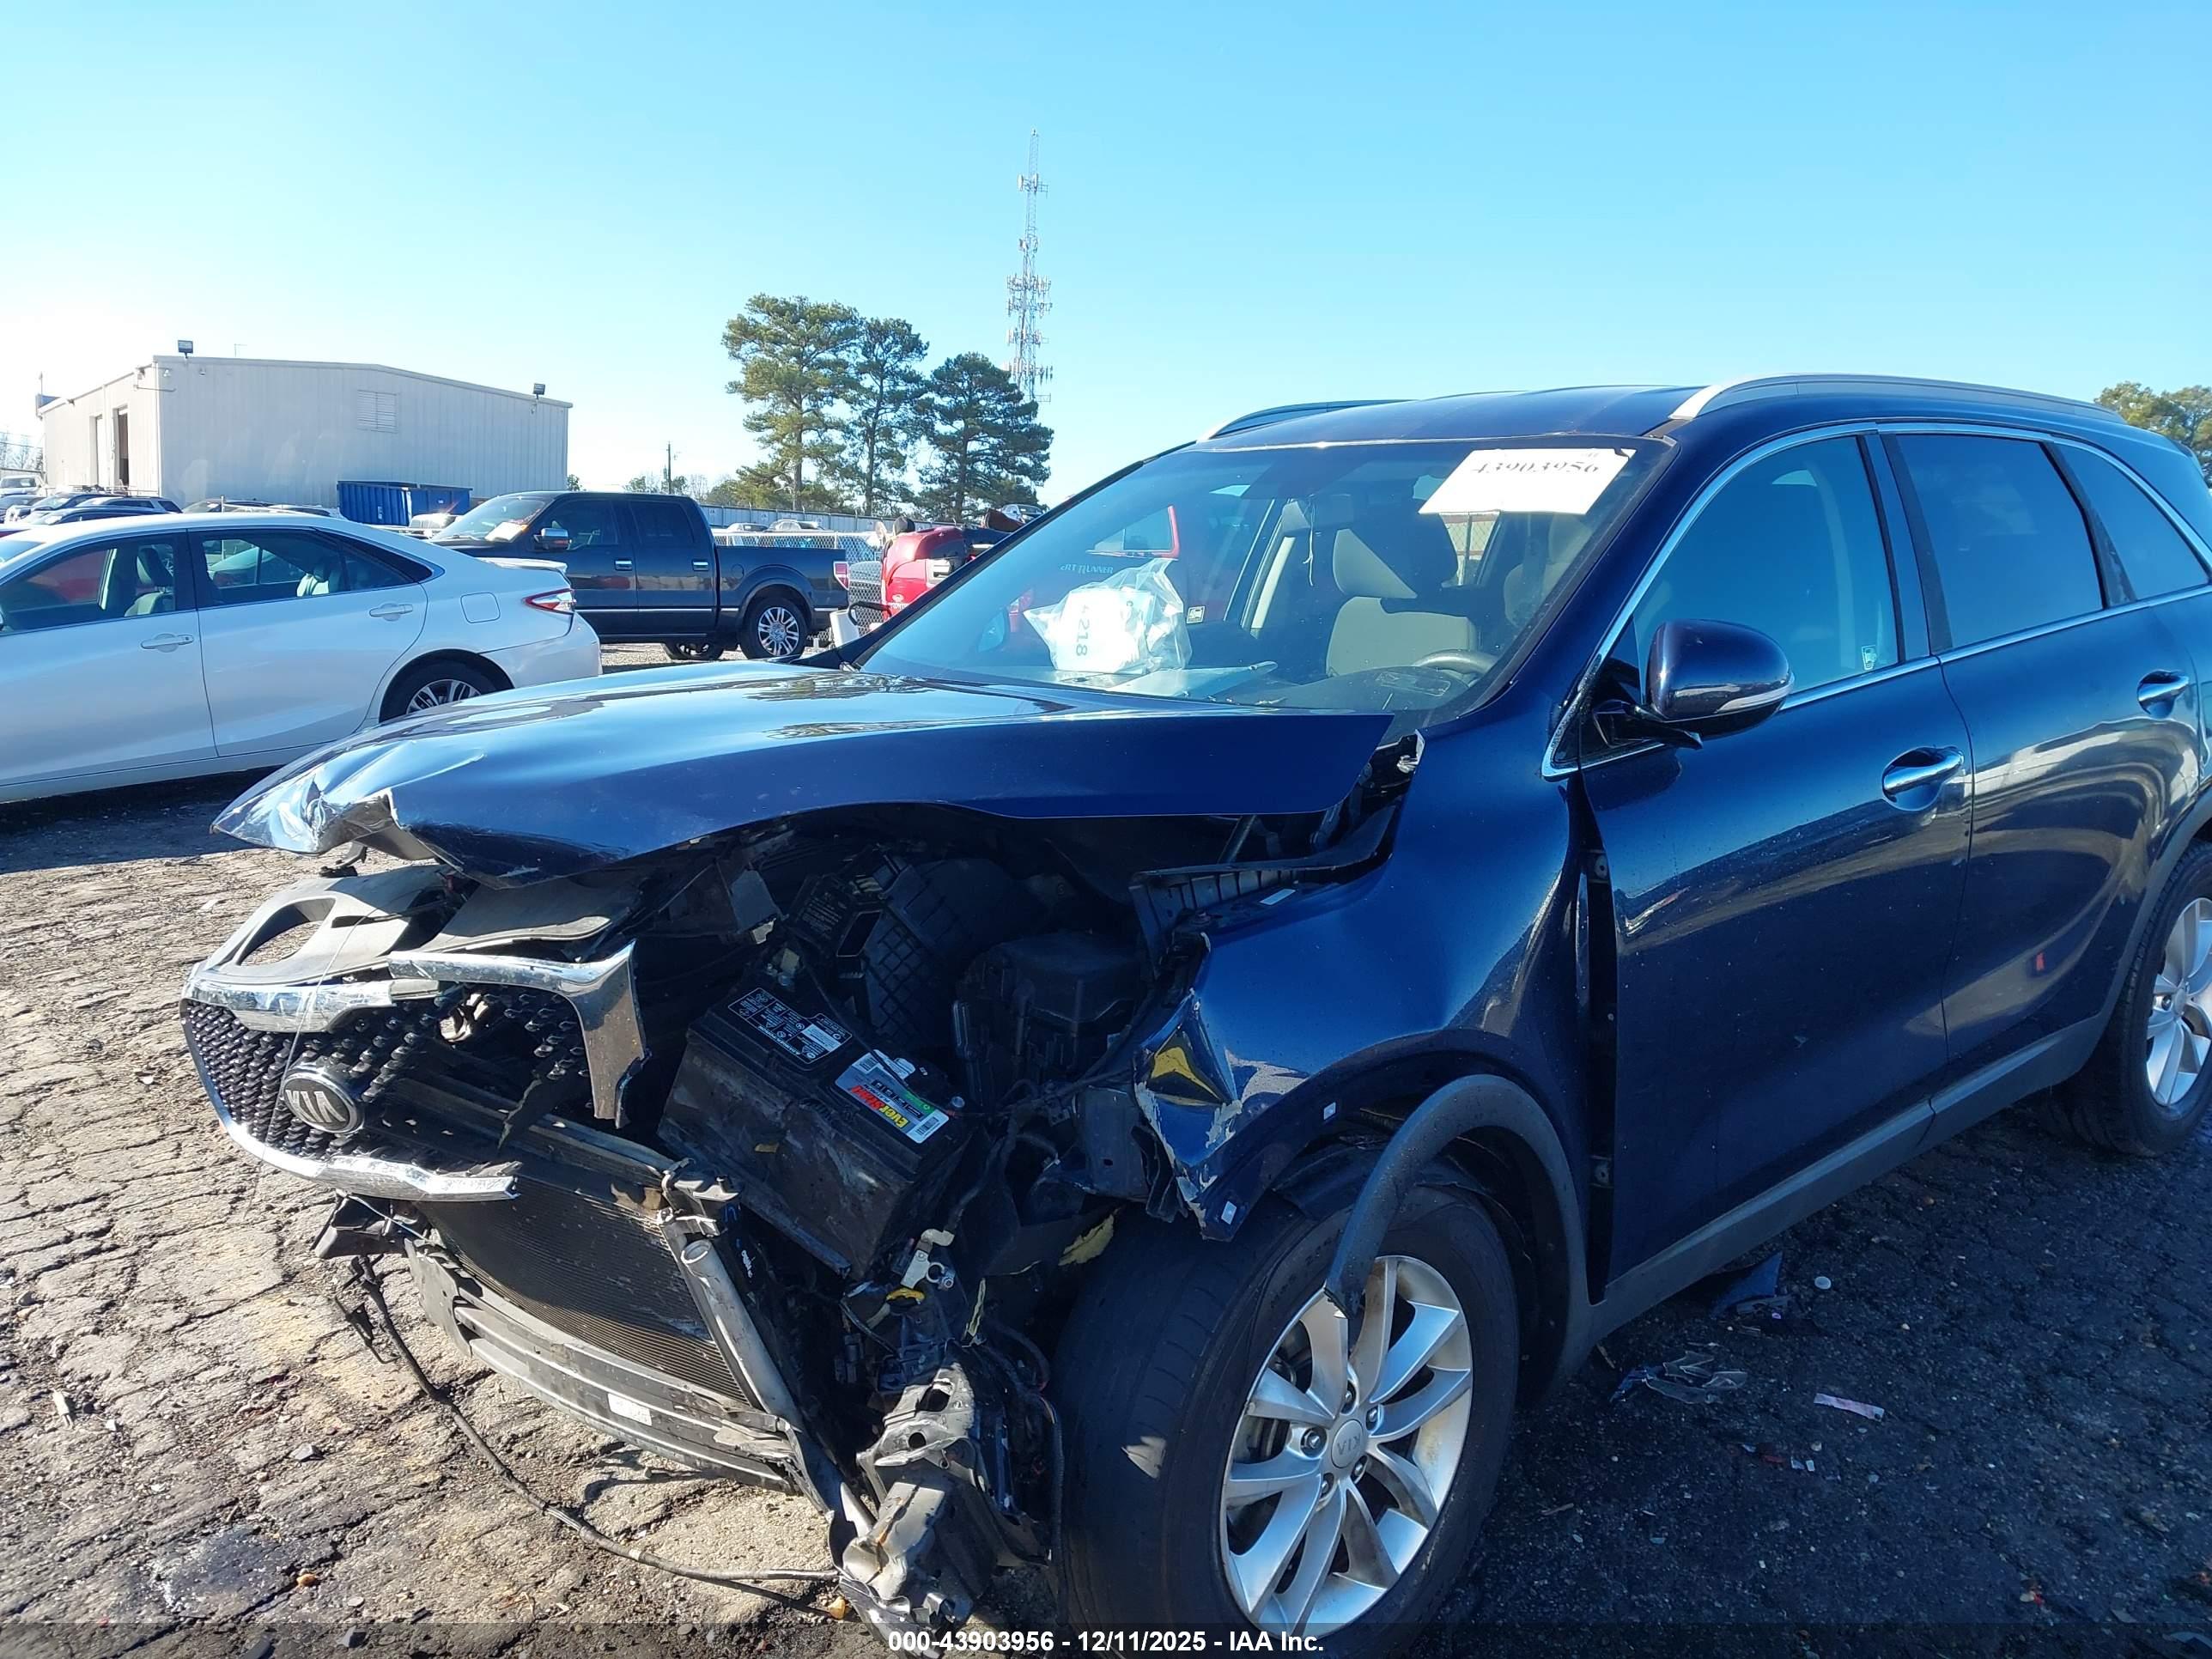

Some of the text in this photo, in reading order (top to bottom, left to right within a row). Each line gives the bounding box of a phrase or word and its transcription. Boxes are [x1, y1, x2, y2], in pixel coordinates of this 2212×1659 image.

[284, 1089, 346, 1123] KIA
[851, 1085, 909, 1128] EverStart
[1336, 1432, 1362, 1455] KIA
